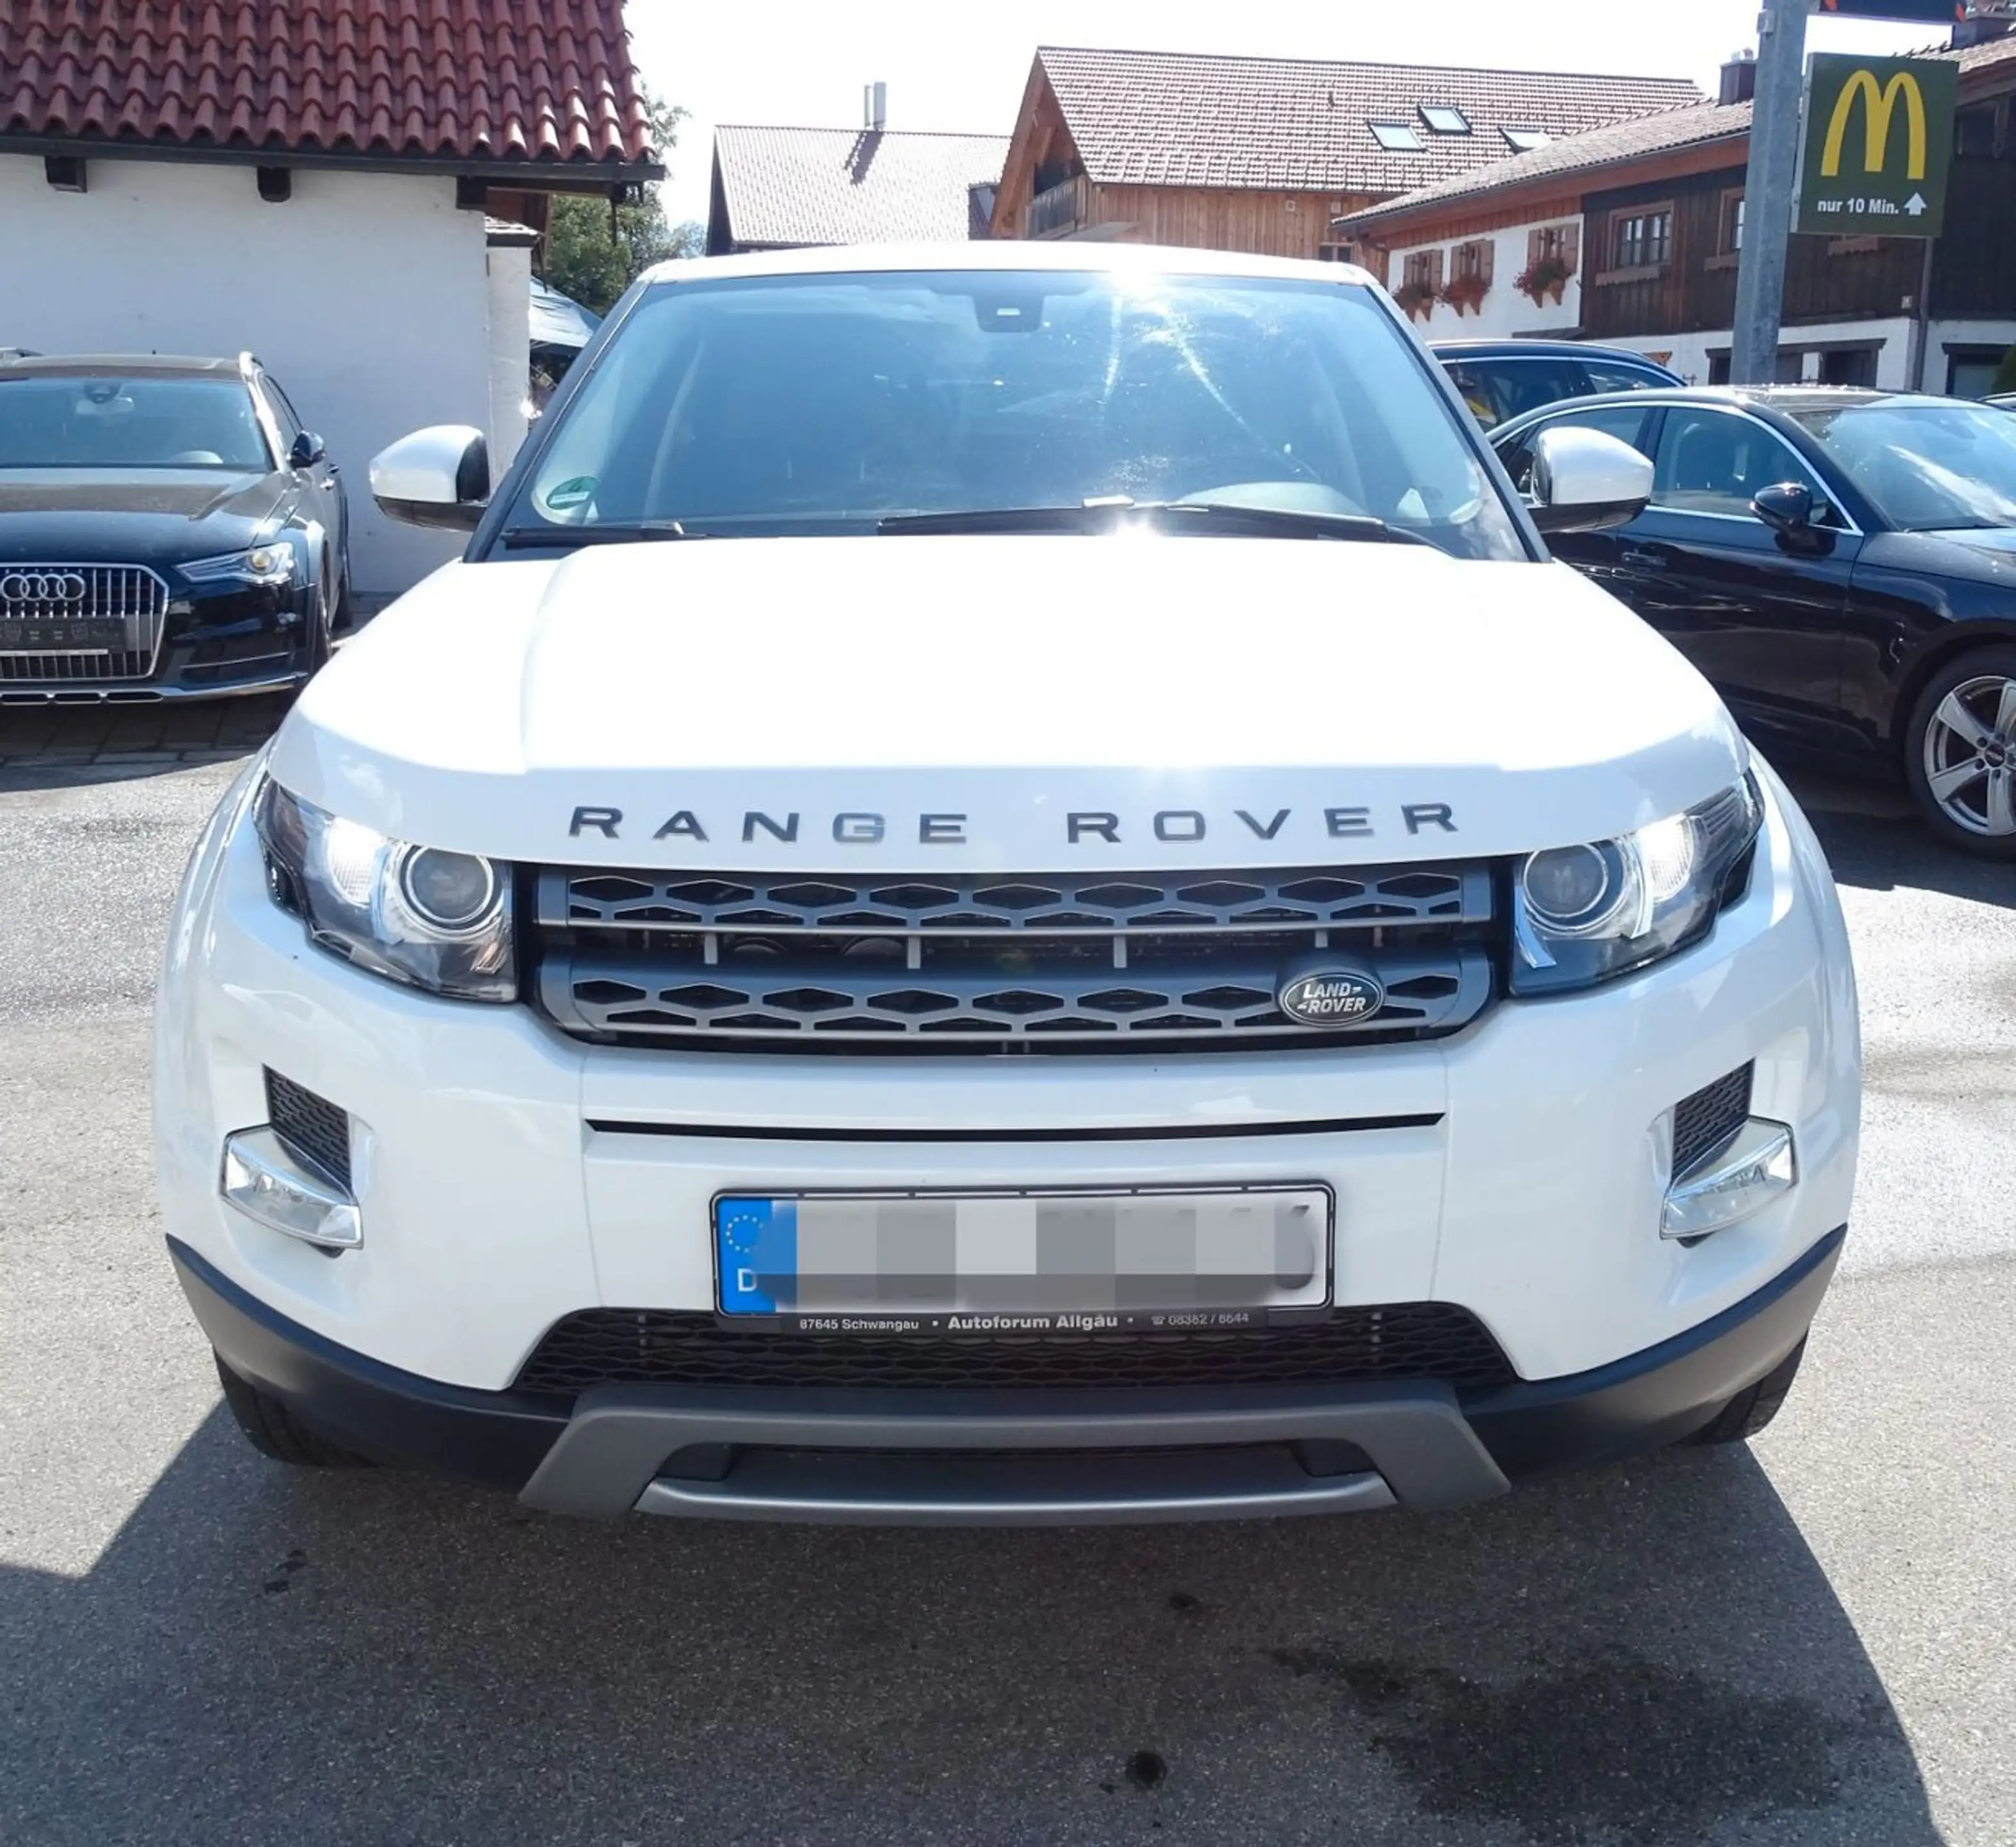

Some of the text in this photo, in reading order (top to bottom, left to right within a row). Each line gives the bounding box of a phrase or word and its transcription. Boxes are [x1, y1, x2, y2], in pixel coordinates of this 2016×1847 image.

[1817, 198, 1899, 214] nur 10 Min.
[569, 802, 1459, 844] RANGE ROVER
[1303, 983, 1351, 999] LAND
[1307, 997, 1366, 1014] ROVER
[737, 1268, 757, 1292] D
[800, 1319, 839, 1330] 87645
[842, 1318, 919, 1332] Schwangau
[948, 1315, 1050, 1330] Autoforum
[1055, 1314, 1118, 1331] Allgäu
